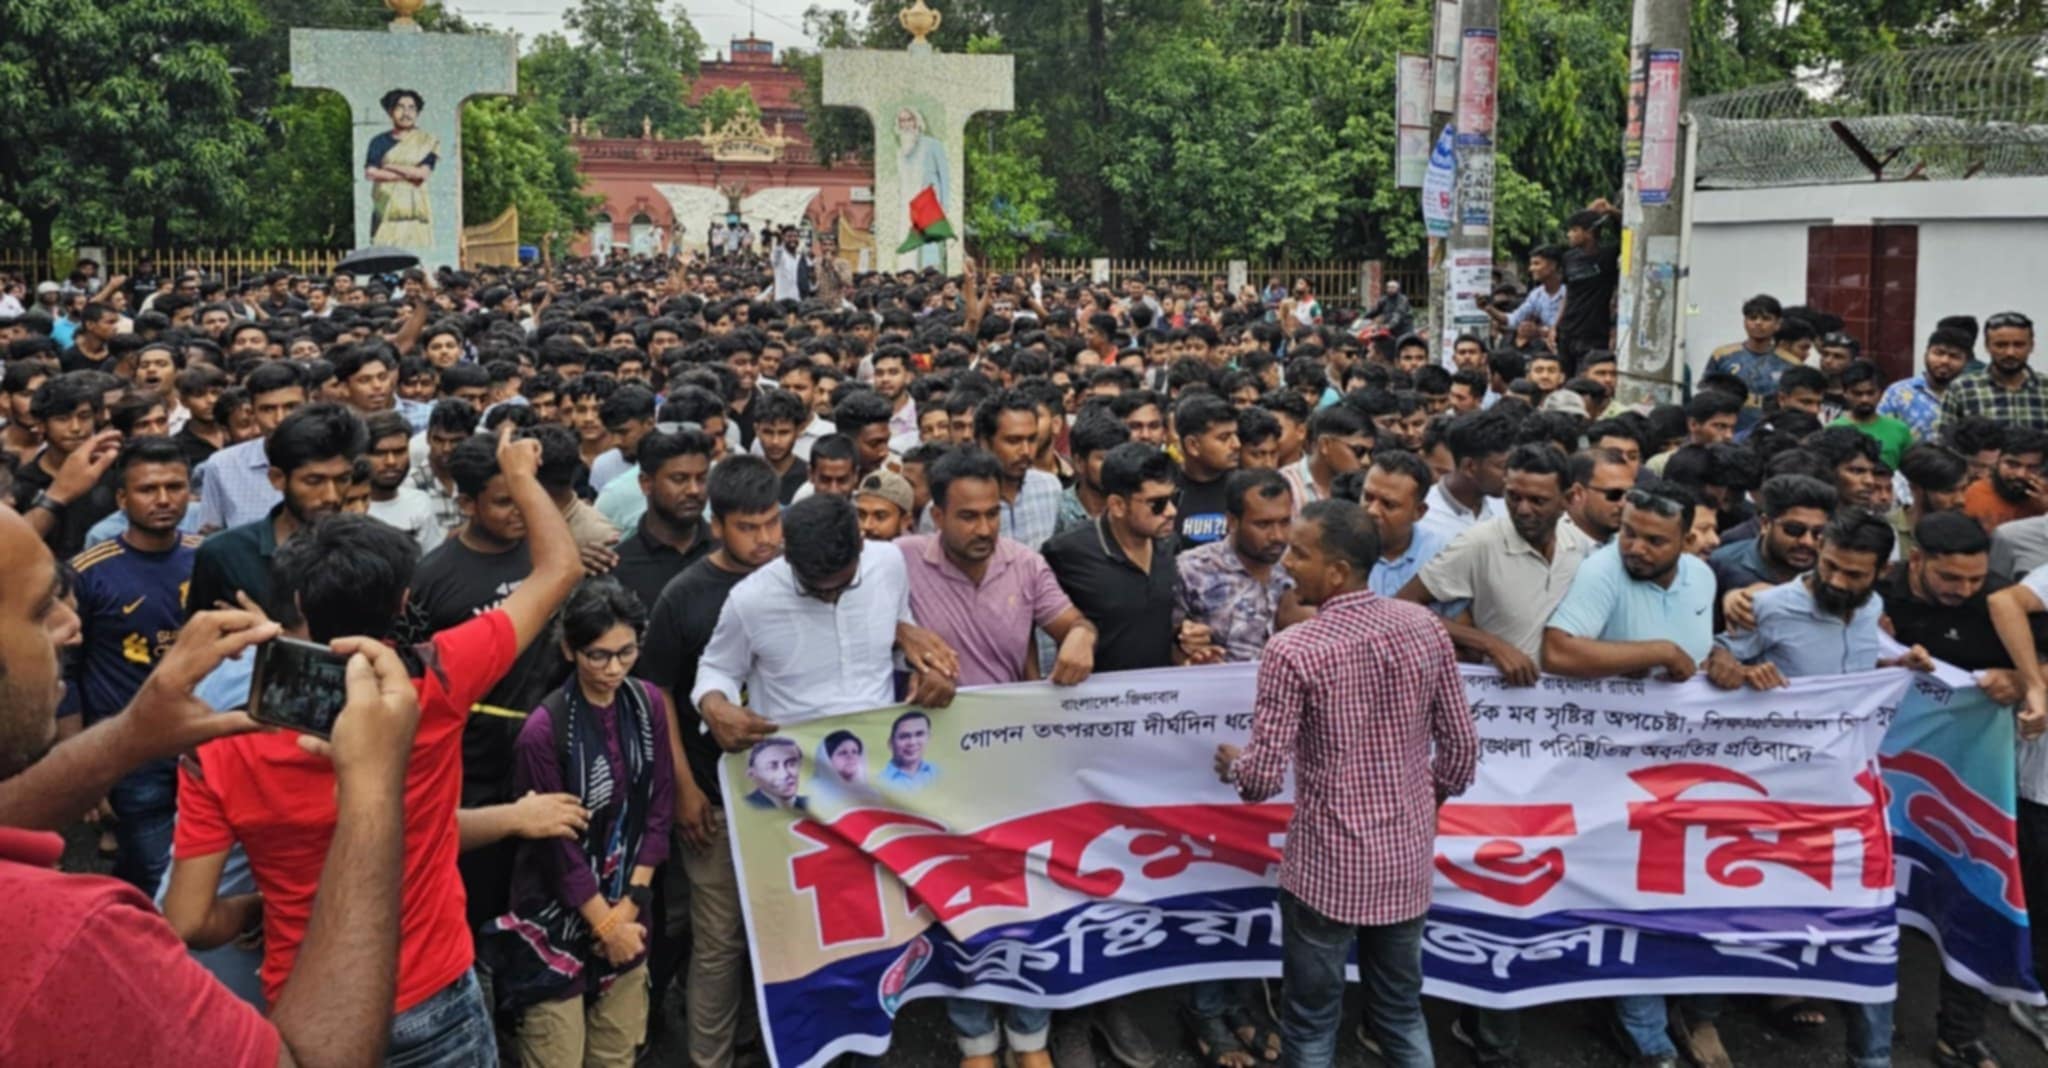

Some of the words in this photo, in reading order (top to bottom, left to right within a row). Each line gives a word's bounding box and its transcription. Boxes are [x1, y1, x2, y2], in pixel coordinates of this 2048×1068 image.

[960, 724, 1024, 751] গোপন
[1031, 718, 1136, 739] তৎপরতায়
[1142, 710, 1217, 736] দীর্ঘদিন
[1507, 705, 1538, 724] মব
[1544, 702, 1596, 731] সৃষ্টির
[1722, 735, 1813, 763] প্রতিবাদে
